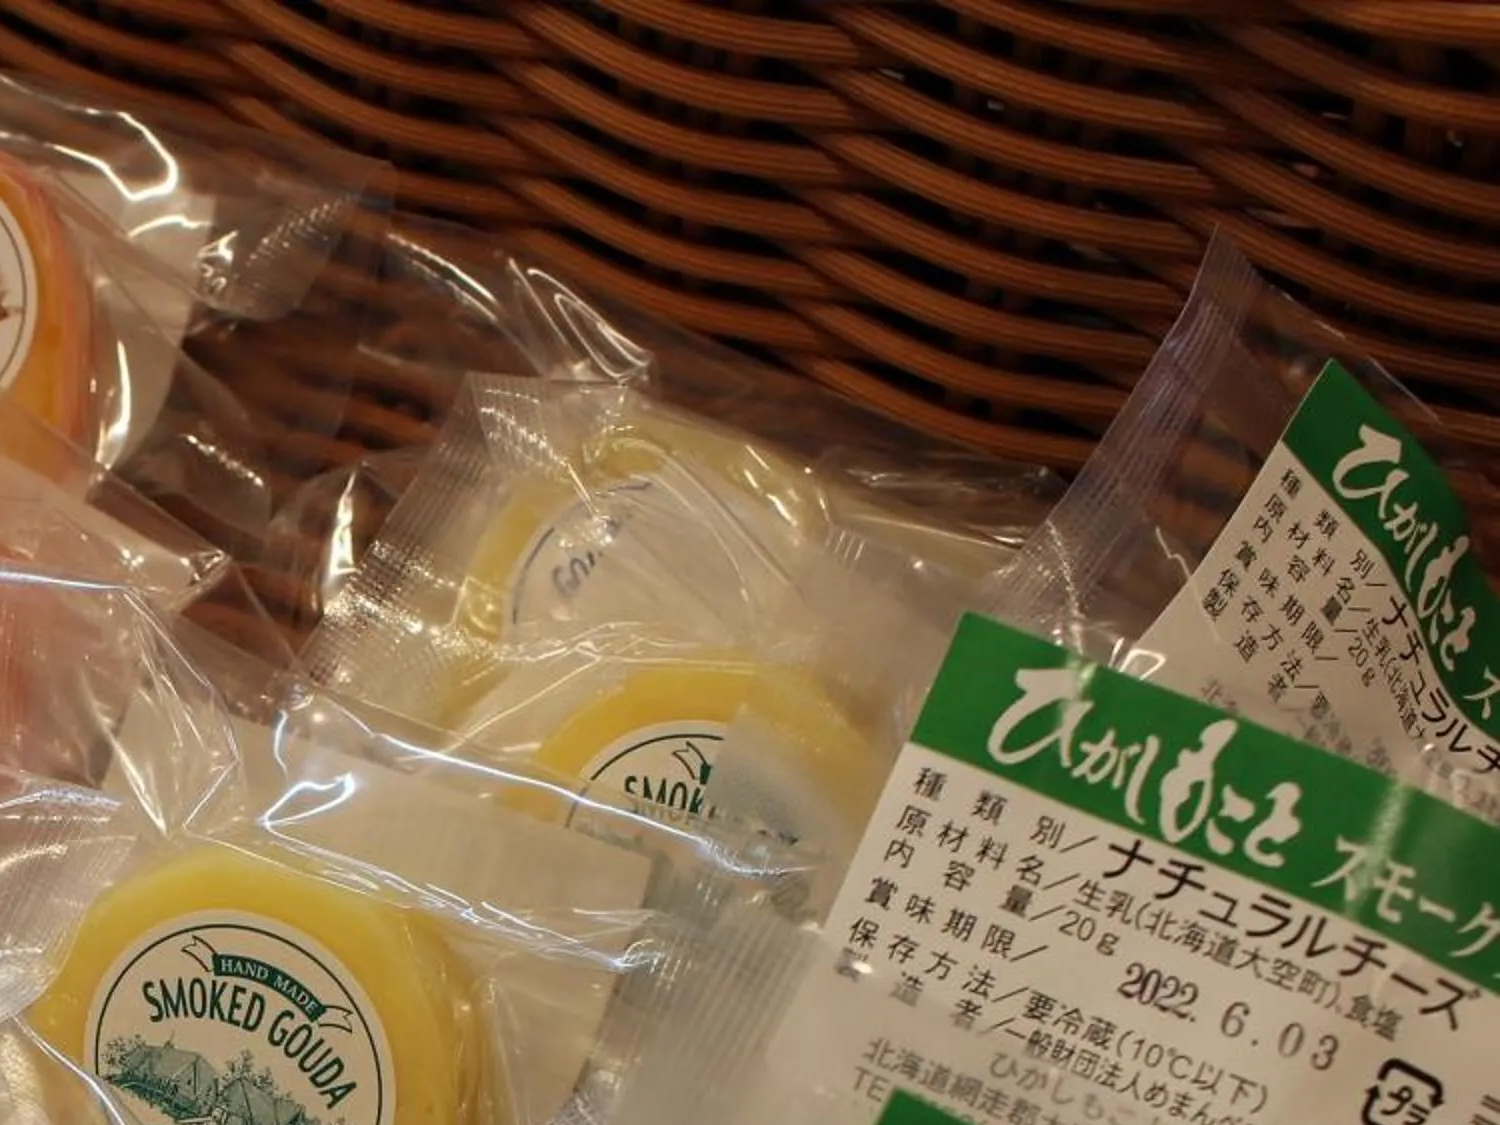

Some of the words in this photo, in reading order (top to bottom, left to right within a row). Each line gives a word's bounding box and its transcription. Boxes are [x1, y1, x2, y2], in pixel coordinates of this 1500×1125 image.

[219, 957, 270, 981] HAND
[272, 972, 320, 1018] MADE
[141, 976, 267, 1033] SMOKED
[267, 1009, 358, 1110] GOUDA
